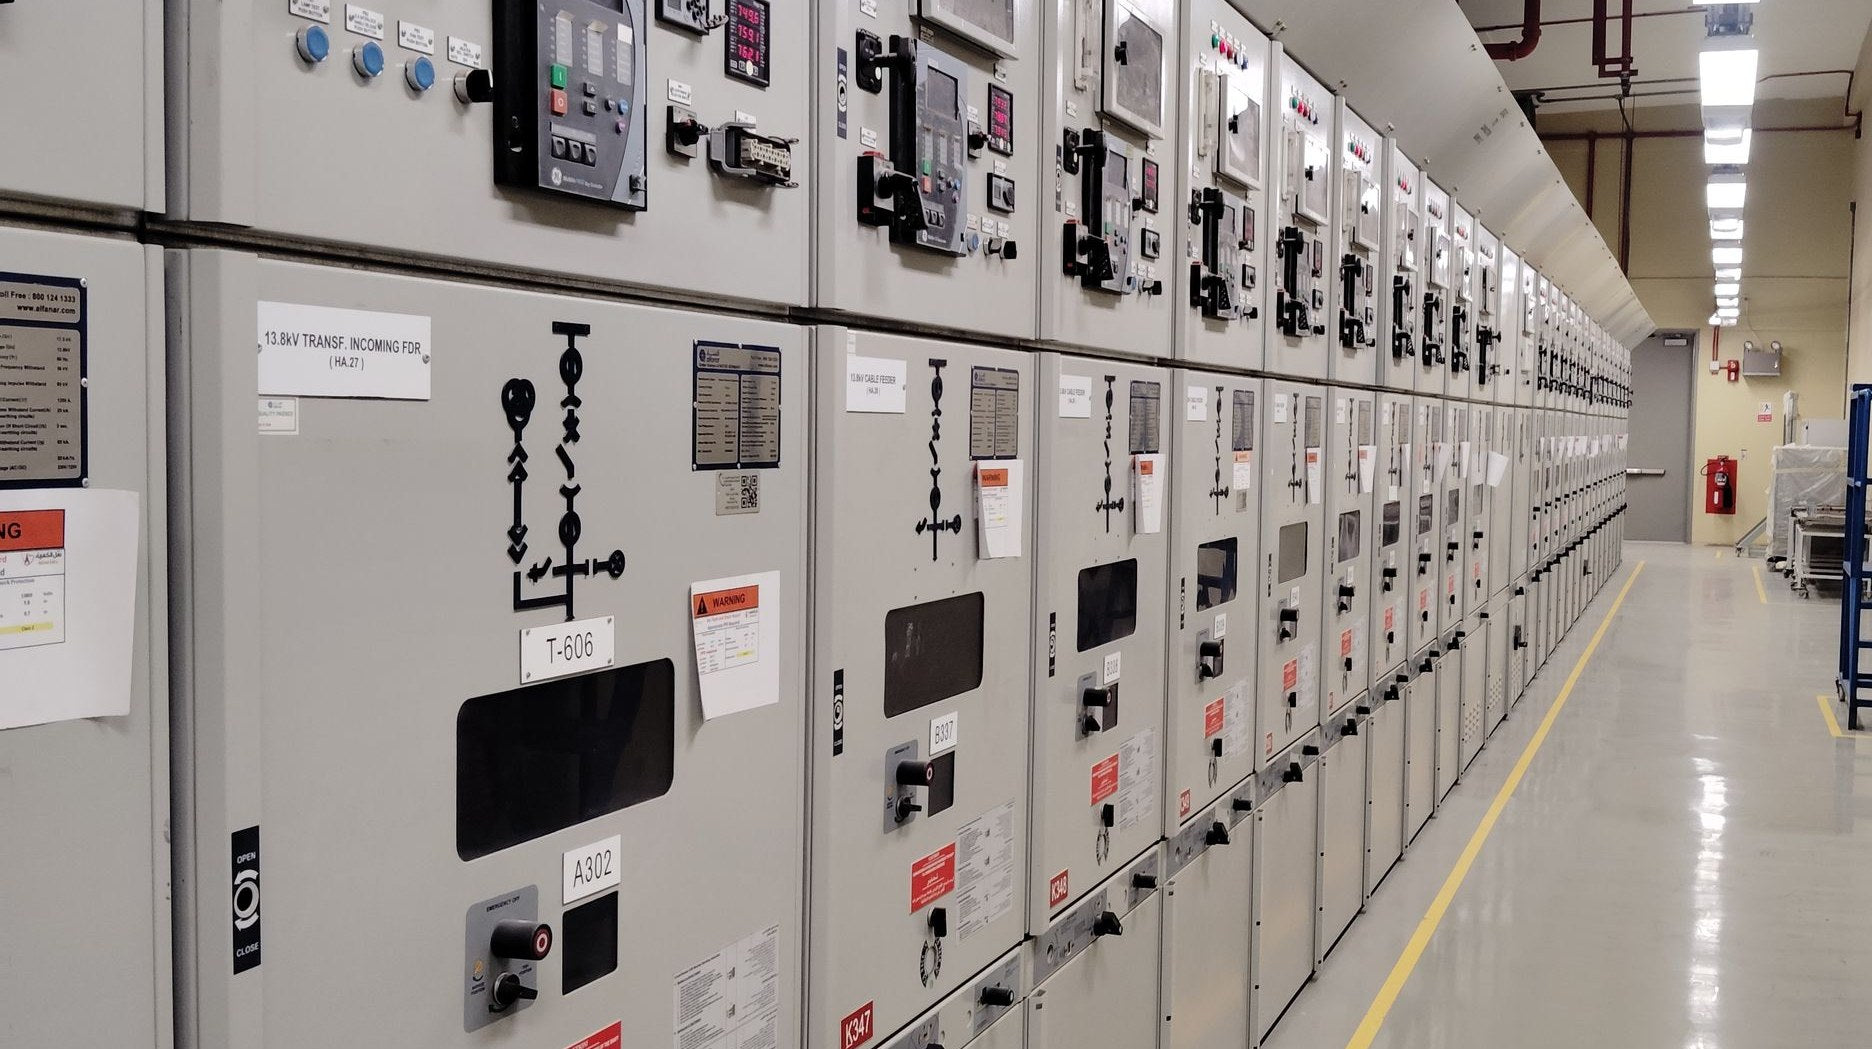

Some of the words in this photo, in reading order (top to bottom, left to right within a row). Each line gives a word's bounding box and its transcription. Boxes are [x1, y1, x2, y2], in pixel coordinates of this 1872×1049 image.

[11, 291, 26, 299] Free
[47, 294, 58, 302] 124
[60, 295, 76, 303] 1333
[17, 304, 76, 315] www.alfanar.com
[265, 330, 300, 347] 13.8kV
[302, 333, 348, 350] TRANSF.
[350, 337, 400, 353] INCOMING
[402, 341, 422, 355] FDR
[713, 593, 746, 608] WARNING
[546, 631, 594, 664] T-606
[935, 720, 954, 745] B337
[236, 850, 257, 865] OPEN
[573, 849, 612, 887] A302
[236, 941, 260, 958] CLOSE
[845, 1009, 871, 1049] K347
